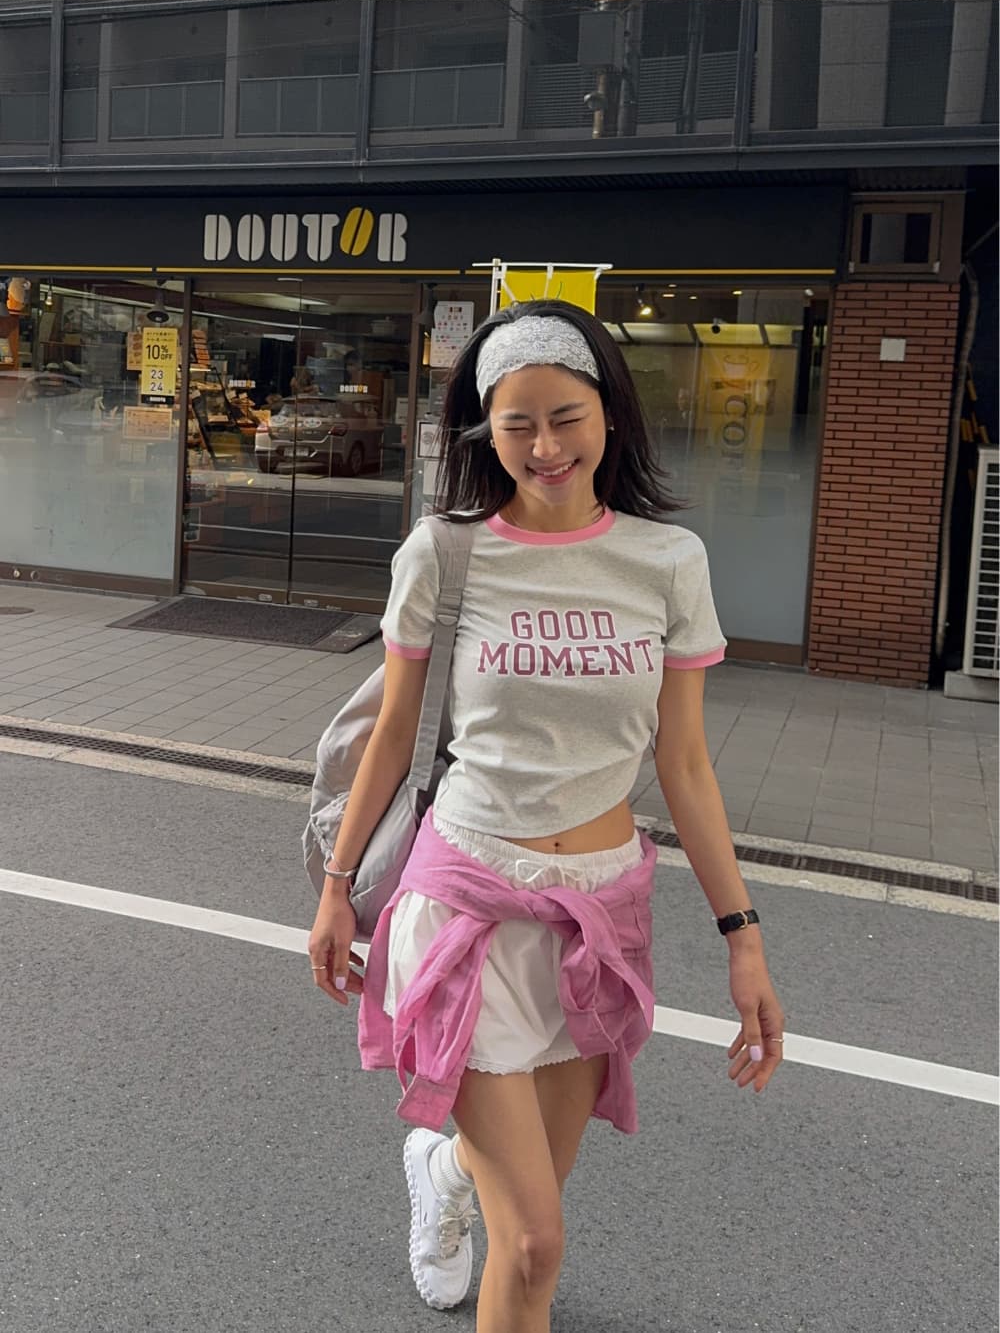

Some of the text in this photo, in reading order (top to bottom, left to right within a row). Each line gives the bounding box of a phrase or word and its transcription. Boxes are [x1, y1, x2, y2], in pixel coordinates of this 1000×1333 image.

[203, 207, 408, 262] DOUTOR
[150, 369, 164, 379] 23
[150, 381, 164, 392] 24
[510, 610, 617, 641] GOOD
[477, 638, 656, 678] MOMENT
